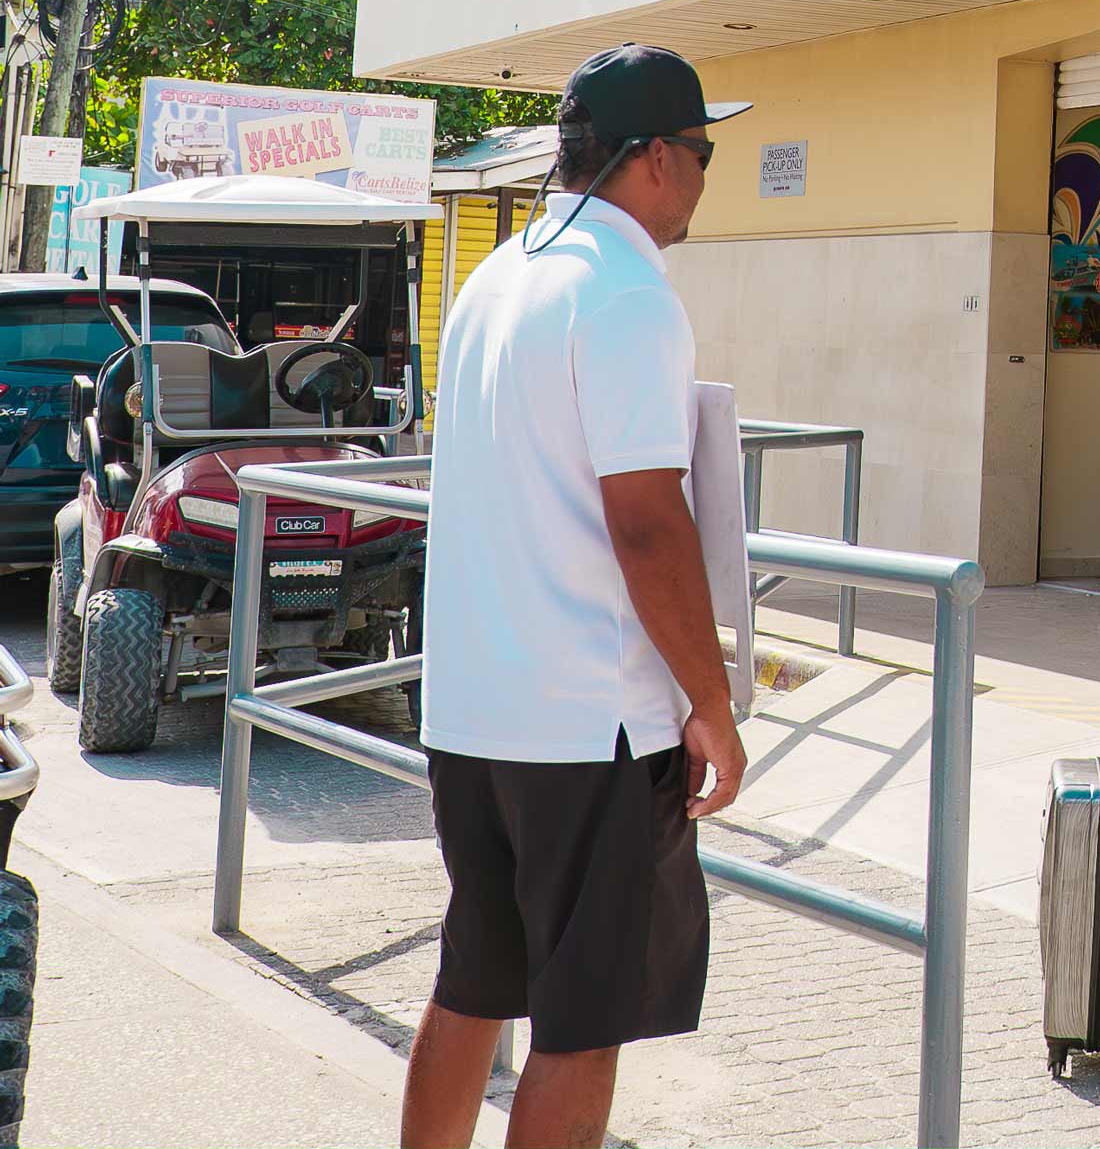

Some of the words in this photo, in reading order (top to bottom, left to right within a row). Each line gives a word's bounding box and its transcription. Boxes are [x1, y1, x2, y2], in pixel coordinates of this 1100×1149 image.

[160, 89, 280, 110] SUPERIOR
[284, 99, 345, 114] GOLF
[347, 103, 418, 120] CARTS
[244, 122, 306, 153] WALK
[311, 117, 334, 141] IN
[379, 127, 428, 144] BEST
[248, 136, 342, 173] SPECIALS
[366, 143, 428, 160] CARTS
[767, 146, 800, 161] PASSENGER
[786, 158, 803, 170] ONLY
[281, 520, 303, 530] Club
[303, 520, 320, 529] Car
